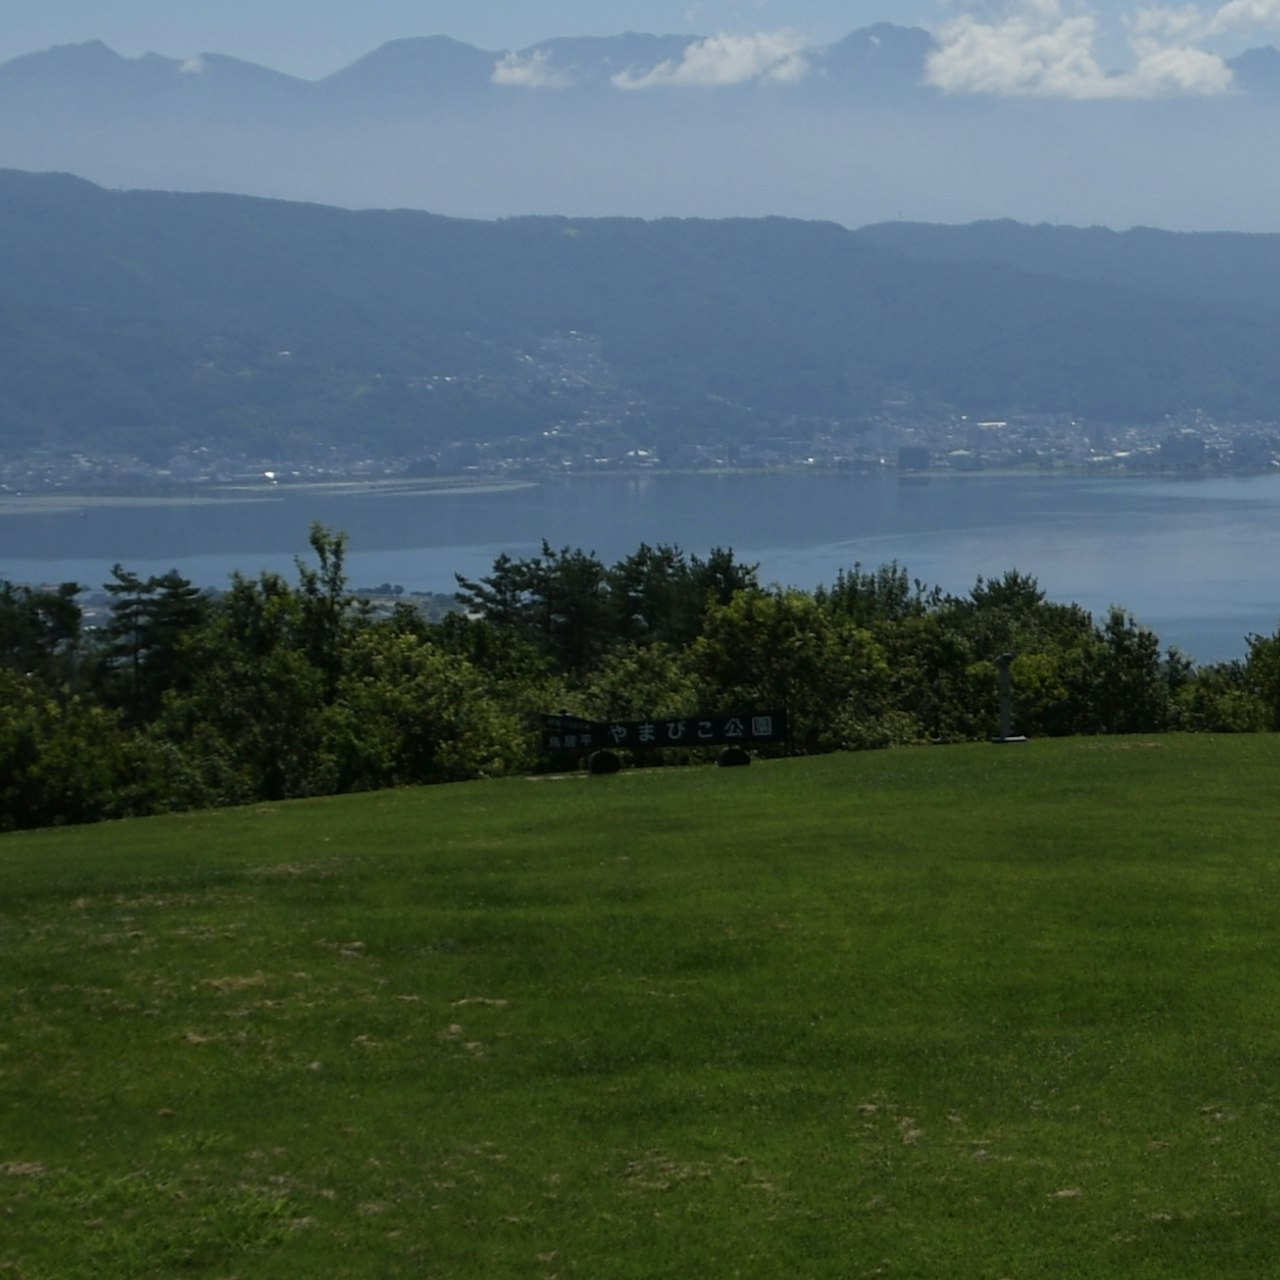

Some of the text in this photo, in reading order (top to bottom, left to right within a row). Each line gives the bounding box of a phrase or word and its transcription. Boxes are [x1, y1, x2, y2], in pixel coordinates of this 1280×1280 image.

[608, 715, 772, 743] やまびこ公園
